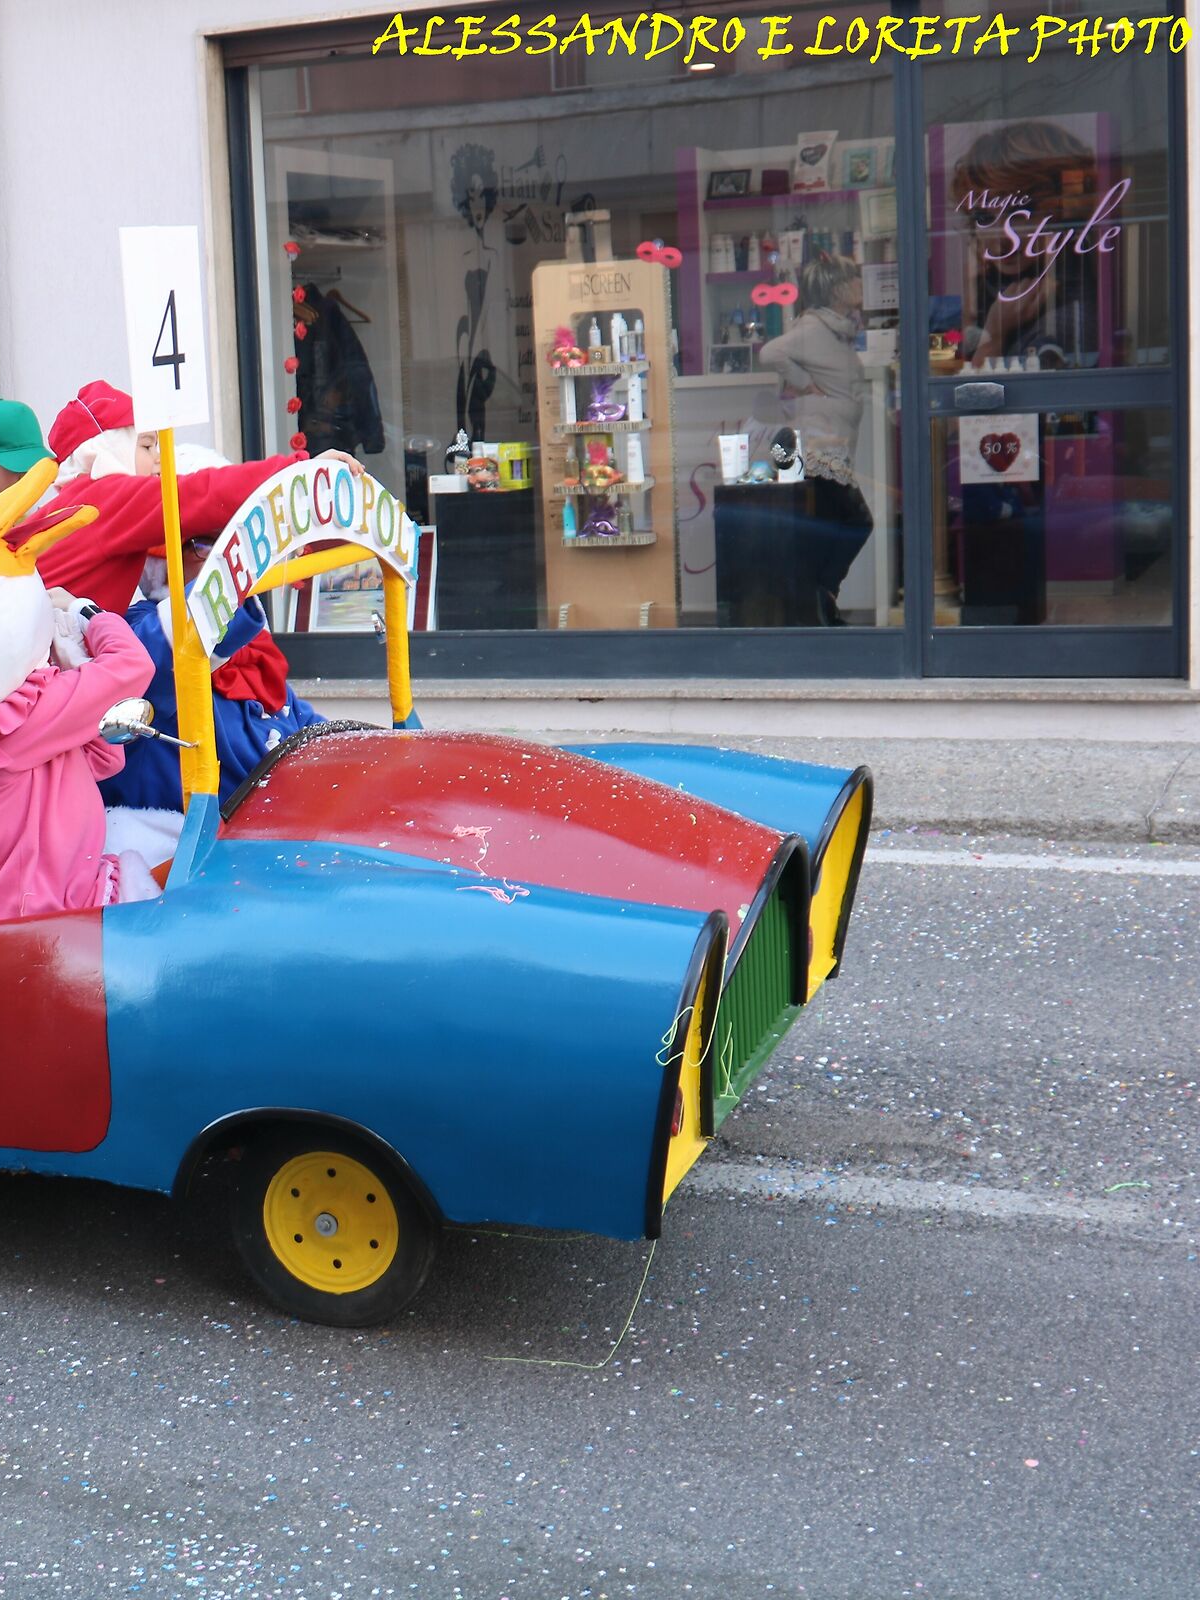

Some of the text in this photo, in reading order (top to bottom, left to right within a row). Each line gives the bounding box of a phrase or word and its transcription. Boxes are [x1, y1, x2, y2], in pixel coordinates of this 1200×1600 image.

[500, 166, 537, 199] Hair
[956, 189, 1032, 229] Magic
[983, 177, 1132, 302] Style
[583, 271, 632, 297] SCREEN
[152, 289, 186, 390] 4
[983, 441, 1002, 455] 50
